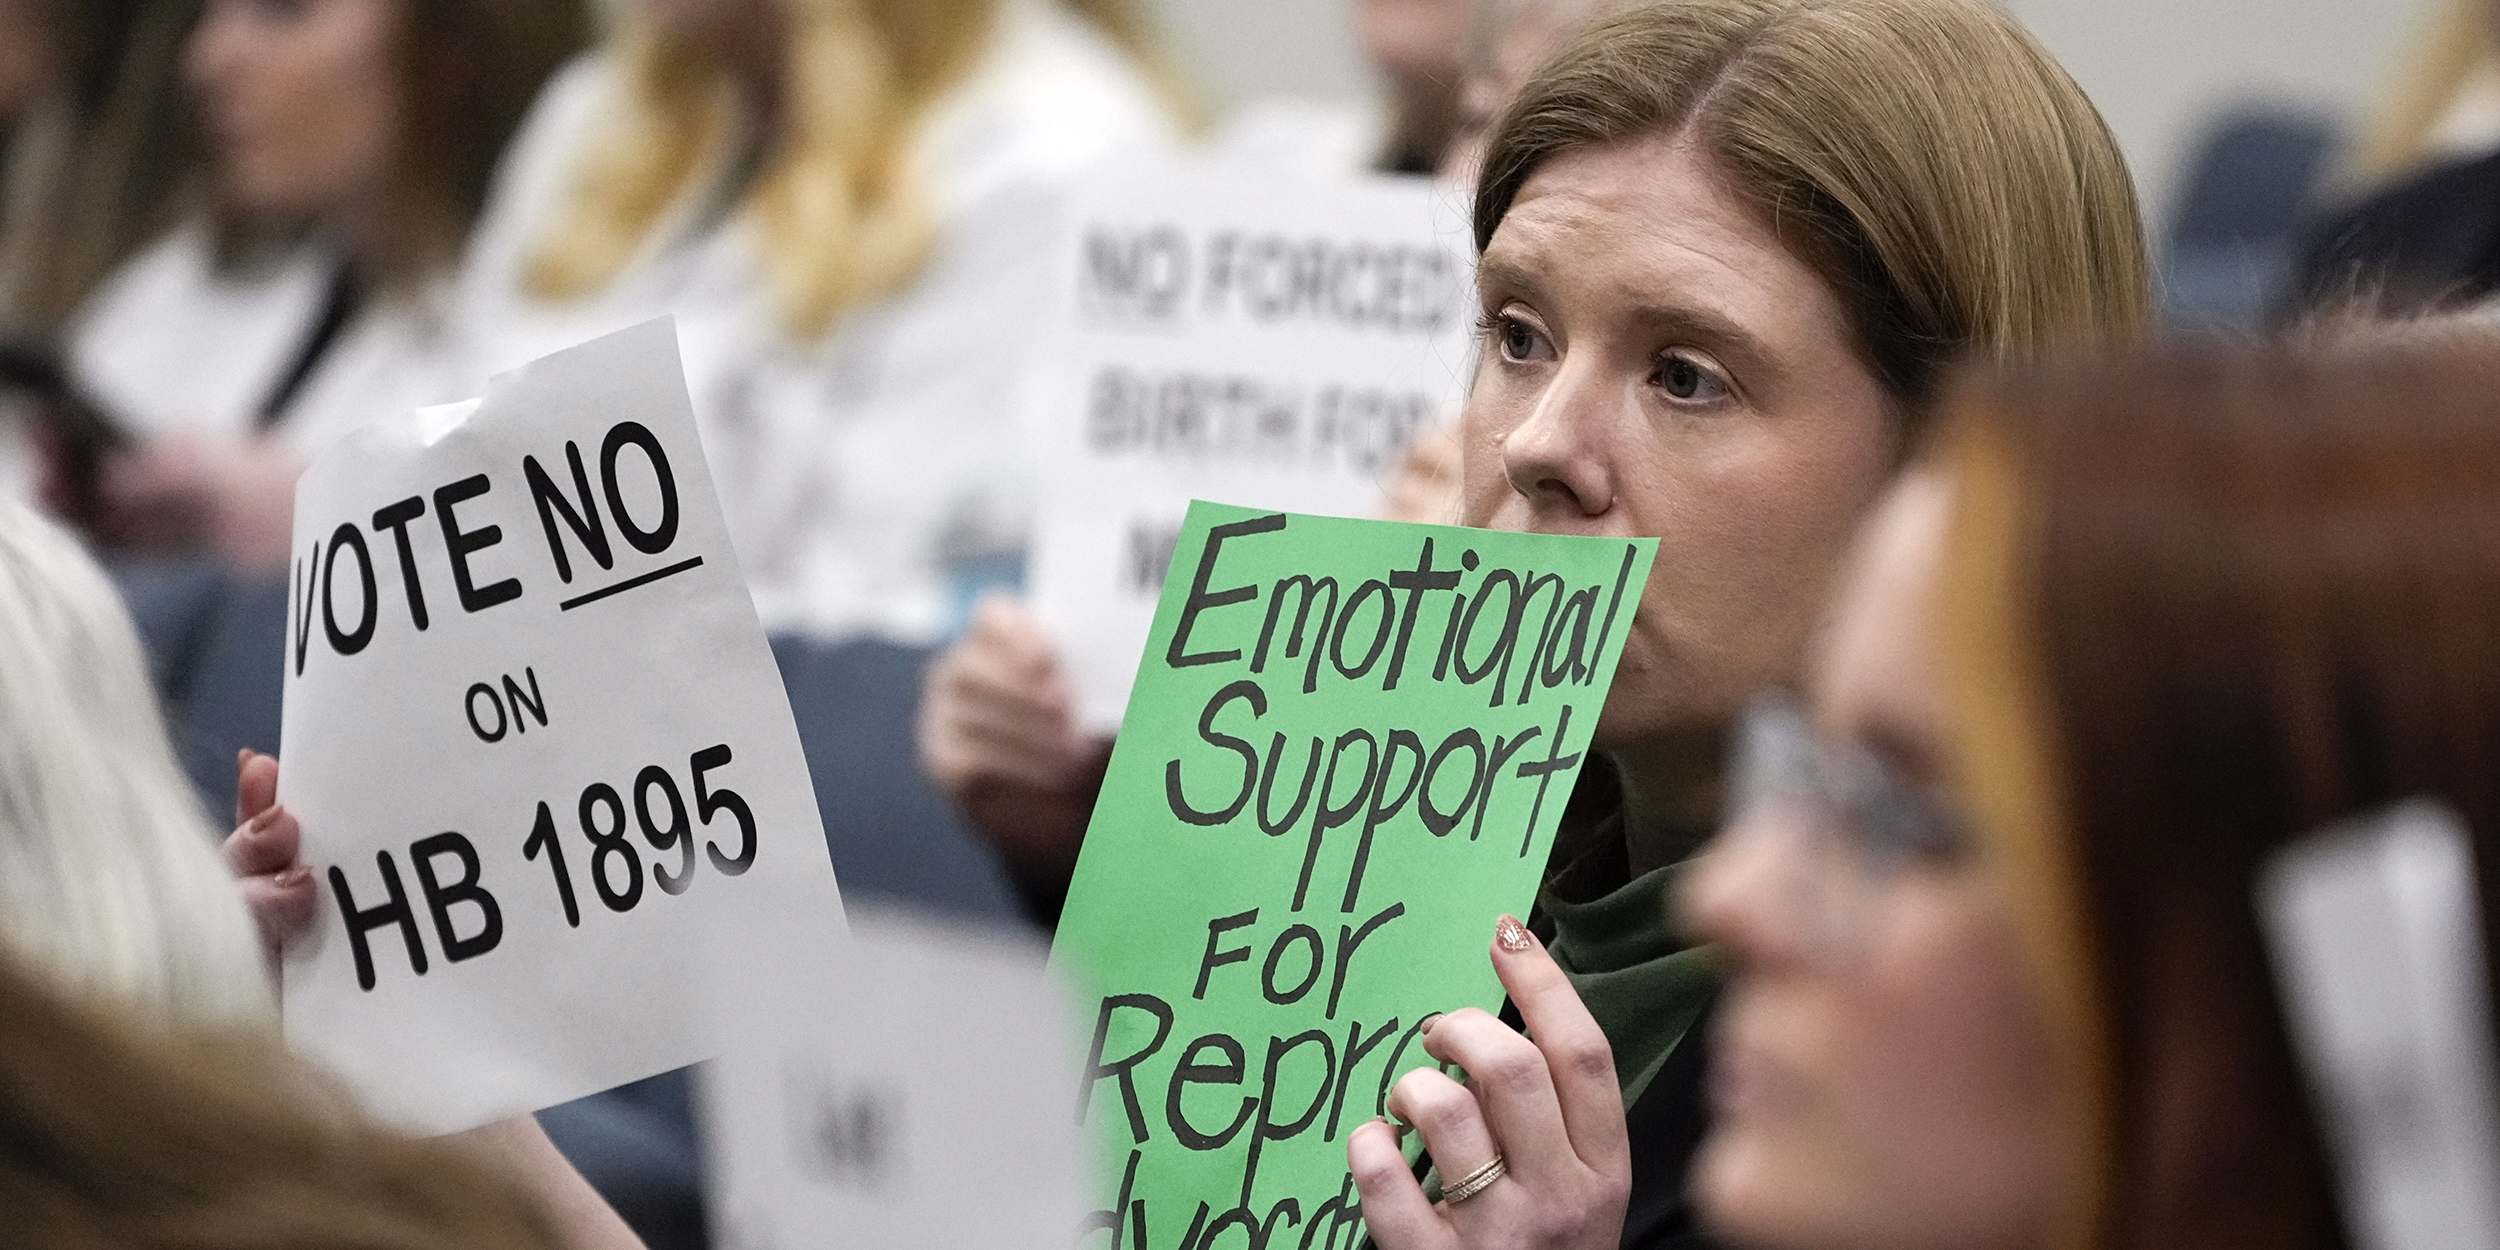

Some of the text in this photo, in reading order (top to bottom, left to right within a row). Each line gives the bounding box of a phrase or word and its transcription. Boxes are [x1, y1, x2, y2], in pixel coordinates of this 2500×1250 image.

[1082, 224, 1460, 336] NO FORCED
[1088, 367, 1303, 465] BIRTH
[295, 421, 680, 679] VOTE NO
[1165, 513, 1637, 708] Emotional
[464, 666, 549, 743] ON
[1165, 679, 1582, 912] Support
[328, 743, 758, 992] HB 1895
